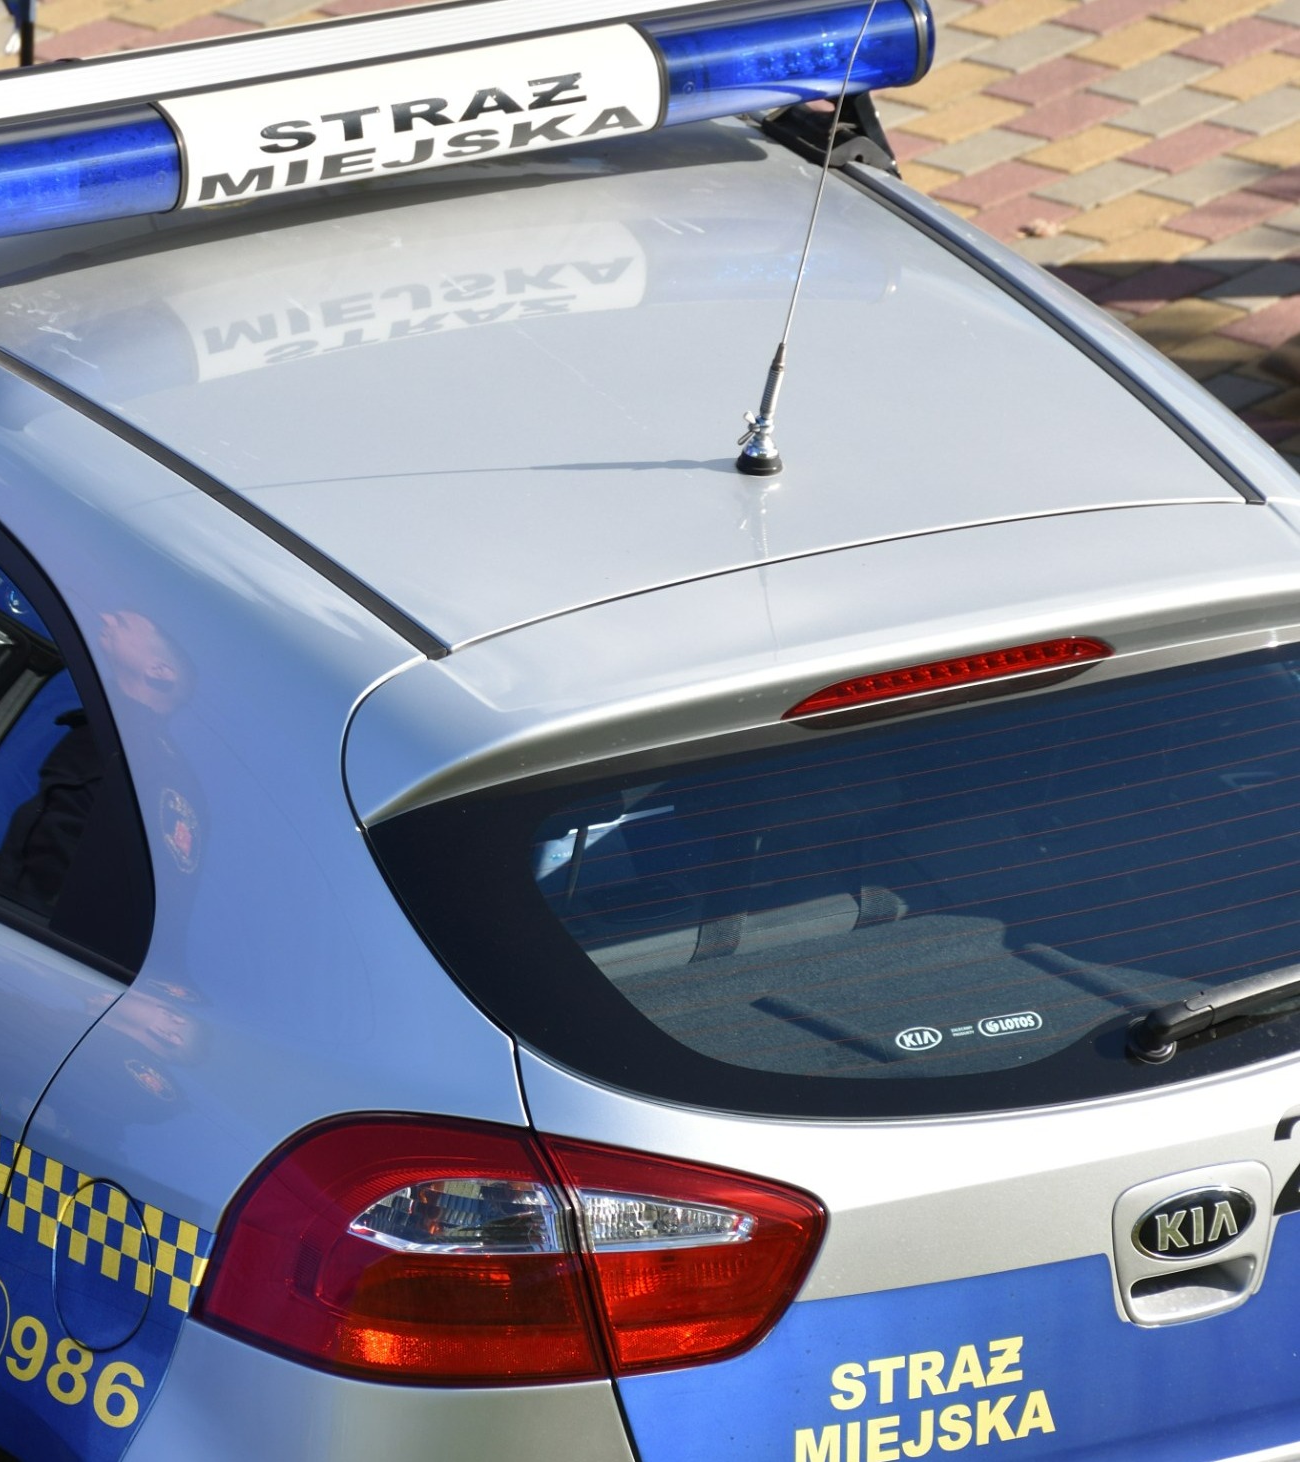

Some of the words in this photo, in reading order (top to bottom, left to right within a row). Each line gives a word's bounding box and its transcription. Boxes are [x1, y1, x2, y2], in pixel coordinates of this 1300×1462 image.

[198, 105, 644, 201] MIEJSKA
[902, 1030, 936, 1047] KIA
[999, 1015, 1036, 1032] LOTOS
[1155, 1200, 1238, 1251] KIA
[5, 1315, 145, 1429] 986
[830, 1335, 1024, 1411] STRAŻ
[795, 1389, 1056, 1462] MIEJSKA
